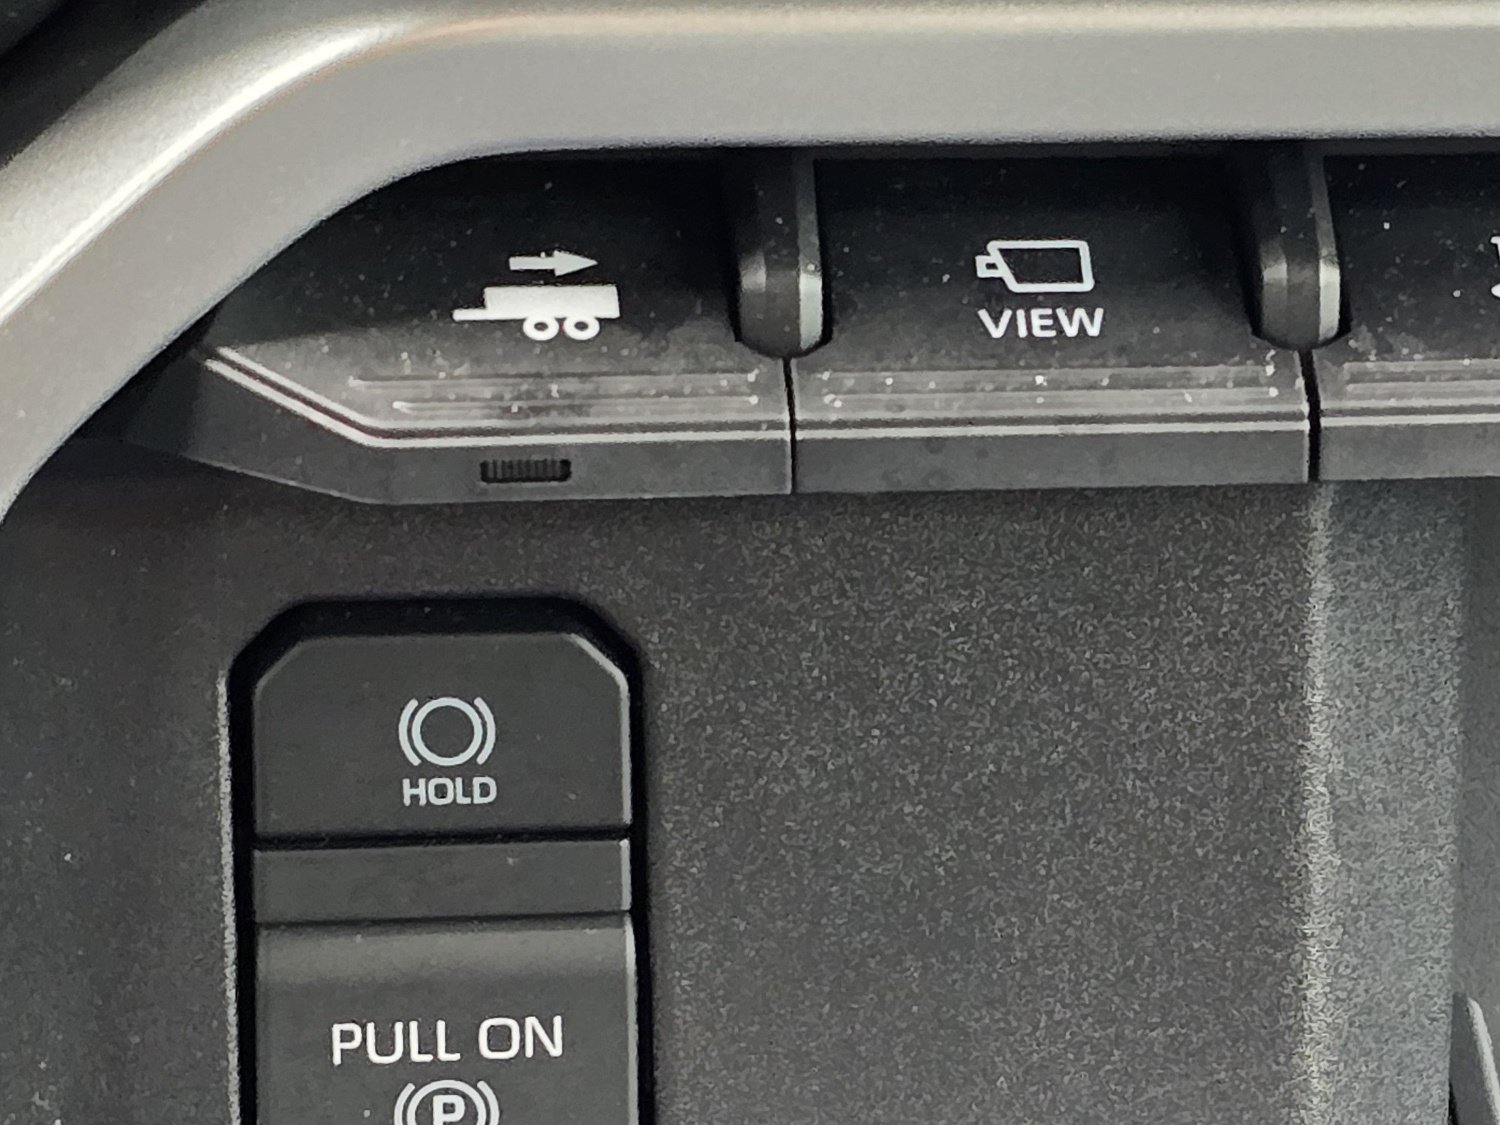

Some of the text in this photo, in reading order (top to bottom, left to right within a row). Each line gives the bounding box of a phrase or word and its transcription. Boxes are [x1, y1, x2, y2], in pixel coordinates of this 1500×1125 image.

[977, 308, 1105, 339] VIEW
[402, 775, 498, 807] HOLD
[331, 1015, 563, 1067] PULL ON
